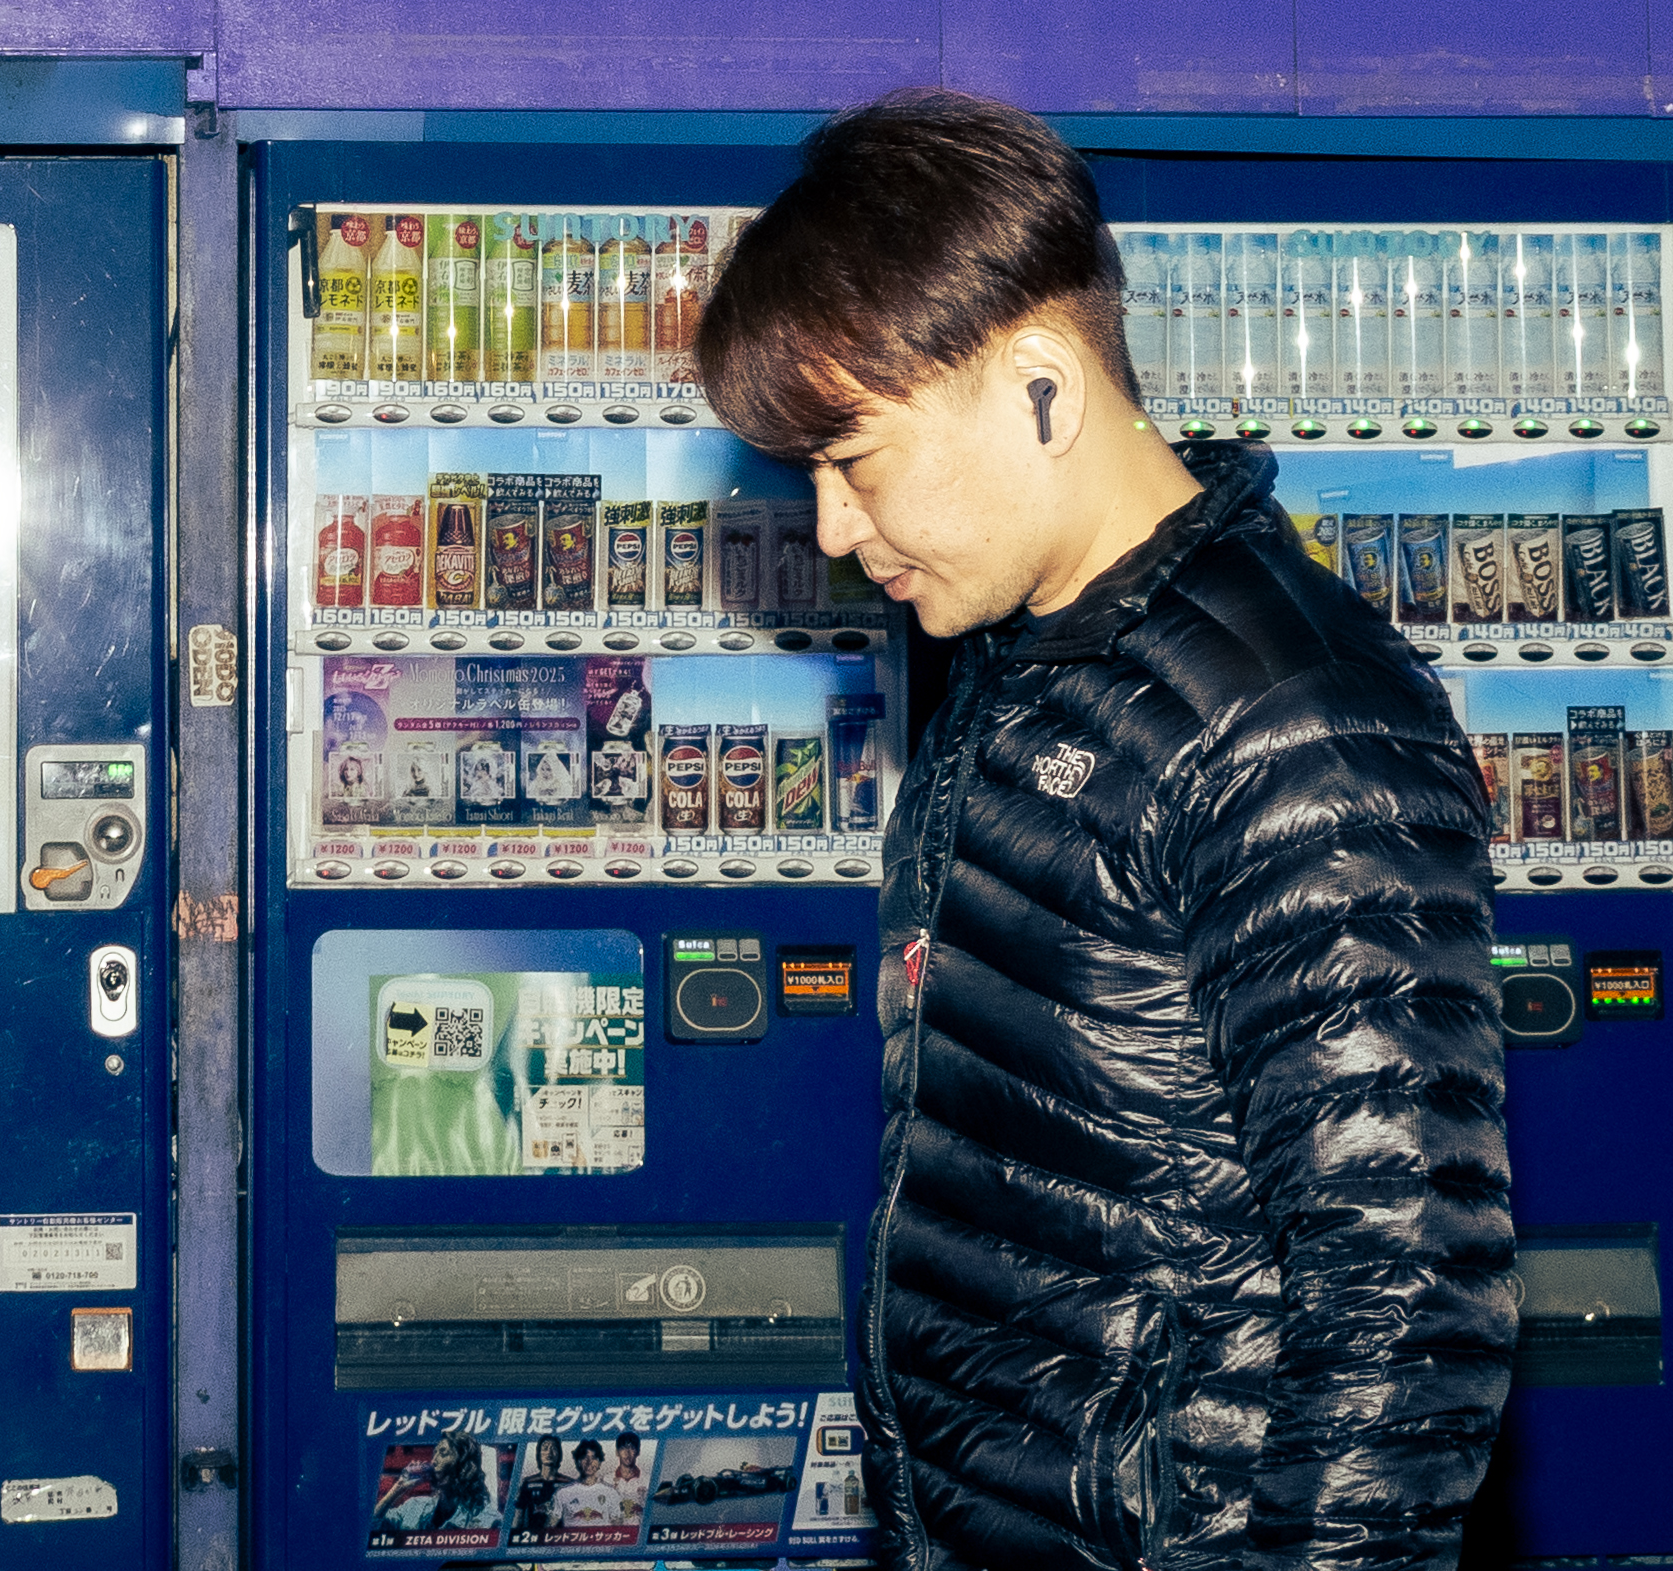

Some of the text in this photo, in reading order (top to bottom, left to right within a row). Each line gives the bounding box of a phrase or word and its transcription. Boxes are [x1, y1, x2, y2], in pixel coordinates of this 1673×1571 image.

[318, 278, 344, 293] 京都
[375, 279, 400, 294] 京都
[318, 293, 364, 308] レモネード
[375, 294, 420, 309] レモネード
[426, 381, 477, 398] 160円
[481, 381, 534, 398] 160円
[544, 382, 594, 399] 150円
[600, 382, 652, 399] 150円
[656, 383, 701, 399] 170
[1143, 398, 1178, 413] 40円
[603, 503, 651, 527] 強刺激
[659, 500, 709, 527] 強刺激
[1472, 541, 1500, 612] BOSS
[1528, 541, 1556, 612] BOSS
[1579, 538, 1613, 617] BLACK
[1631, 532, 1667, 610] BLACK
[314, 609, 365, 625] 160円
[370, 609, 423, 625] 160円
[437, 610, 487, 626] 150円
[496, 611, 544, 626] 150円
[546, 611, 598, 626] 150円
[609, 611, 658, 627] 150円
[665, 612, 715, 627] 150円
[1468, 624, 1515, 639] 140円
[1624, 624, 1667, 639] 40円
[466, 662, 528, 683] Christmas
[530, 666, 565, 683] 2025
[1057, 742, 1085, 765] THE
[667, 762, 704, 772] PEPSI
[724, 761, 761, 772] PEPSI
[1031, 754, 1075, 782] NORTH
[1037, 774, 1071, 796] FACE
[668, 791, 703, 809] COLA
[725, 791, 761, 809] COLA
[669, 836, 718, 852] 150円
[724, 836, 775, 852] 150円
[778, 836, 828, 852] 150円
[832, 836, 881, 852] 220円
[678, 939, 710, 950] Suica
[1490, 945, 1522, 956] Suica
[366, 1400, 809, 1437] レッドブル 限定グッズをゲットしよう!
[405, 1534, 433, 1546] ZETA
[435, 1533, 490, 1546] DIVISION
